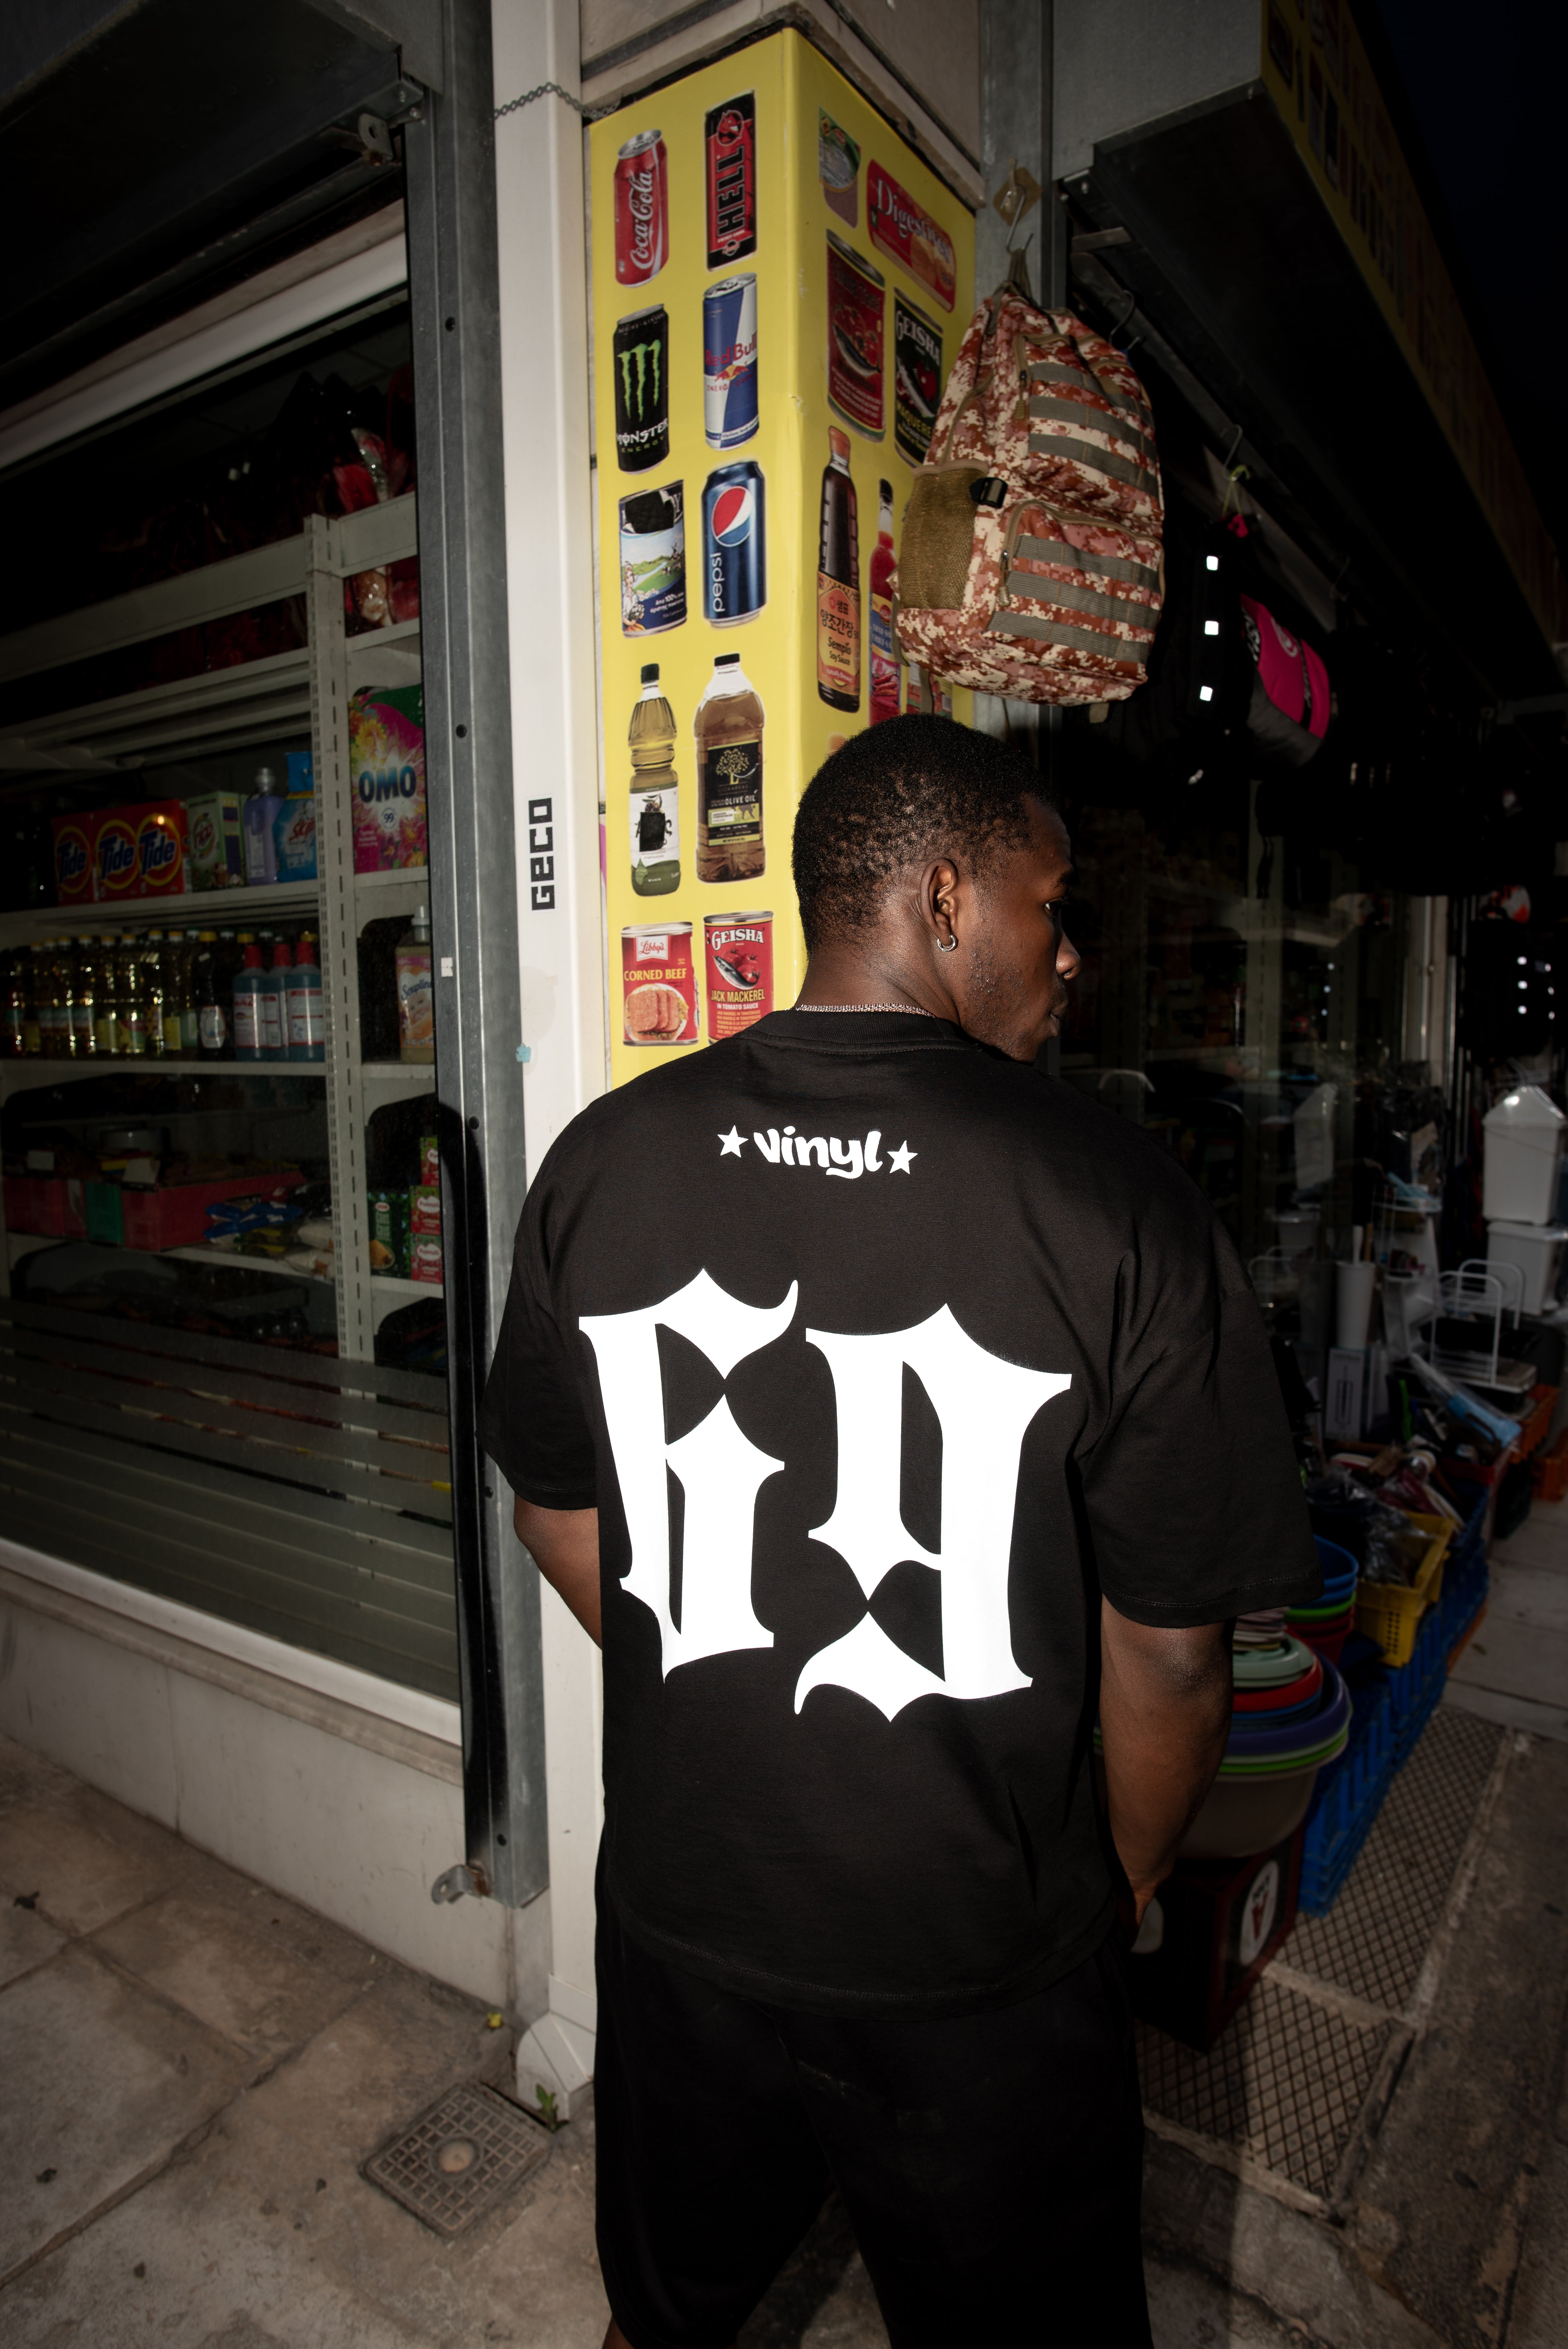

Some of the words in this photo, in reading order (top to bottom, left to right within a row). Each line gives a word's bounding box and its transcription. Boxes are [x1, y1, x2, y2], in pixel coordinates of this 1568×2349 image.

[716, 144, 745, 237] HELL
[877, 176, 950, 264] Digestives
[705, 346, 730, 366] Red
[733, 331, 757, 362] Bull
[895, 310, 941, 366] GEISHA
[617, 417, 669, 447] MONSTER
[621, 435, 665, 453] ENERGY
[709, 552, 726, 612] pepsi
[827, 636, 852, 656] Sempio
[829, 651, 837, 663] Soy
[837, 654, 851, 666] Sauce
[359, 765, 417, 802] OMO
[725, 796, 744, 805] OLIVE
[384, 813, 394, 823] 99
[57, 839, 86, 884] Tide
[99, 833, 135, 881] Tide
[139, 828, 175, 877] Tide
[638, 940, 665, 955] Libby's
[711, 928, 764, 951] GEISHA
[624, 969, 663, 981] CORNED
[665, 968, 687, 979] BEEF
[711, 989, 726, 1002] JACK
[727, 988, 766, 1003] MACKEREL
[753, 1125, 883, 1180] vinyl
[578, 1267, 1072, 1723] 69
